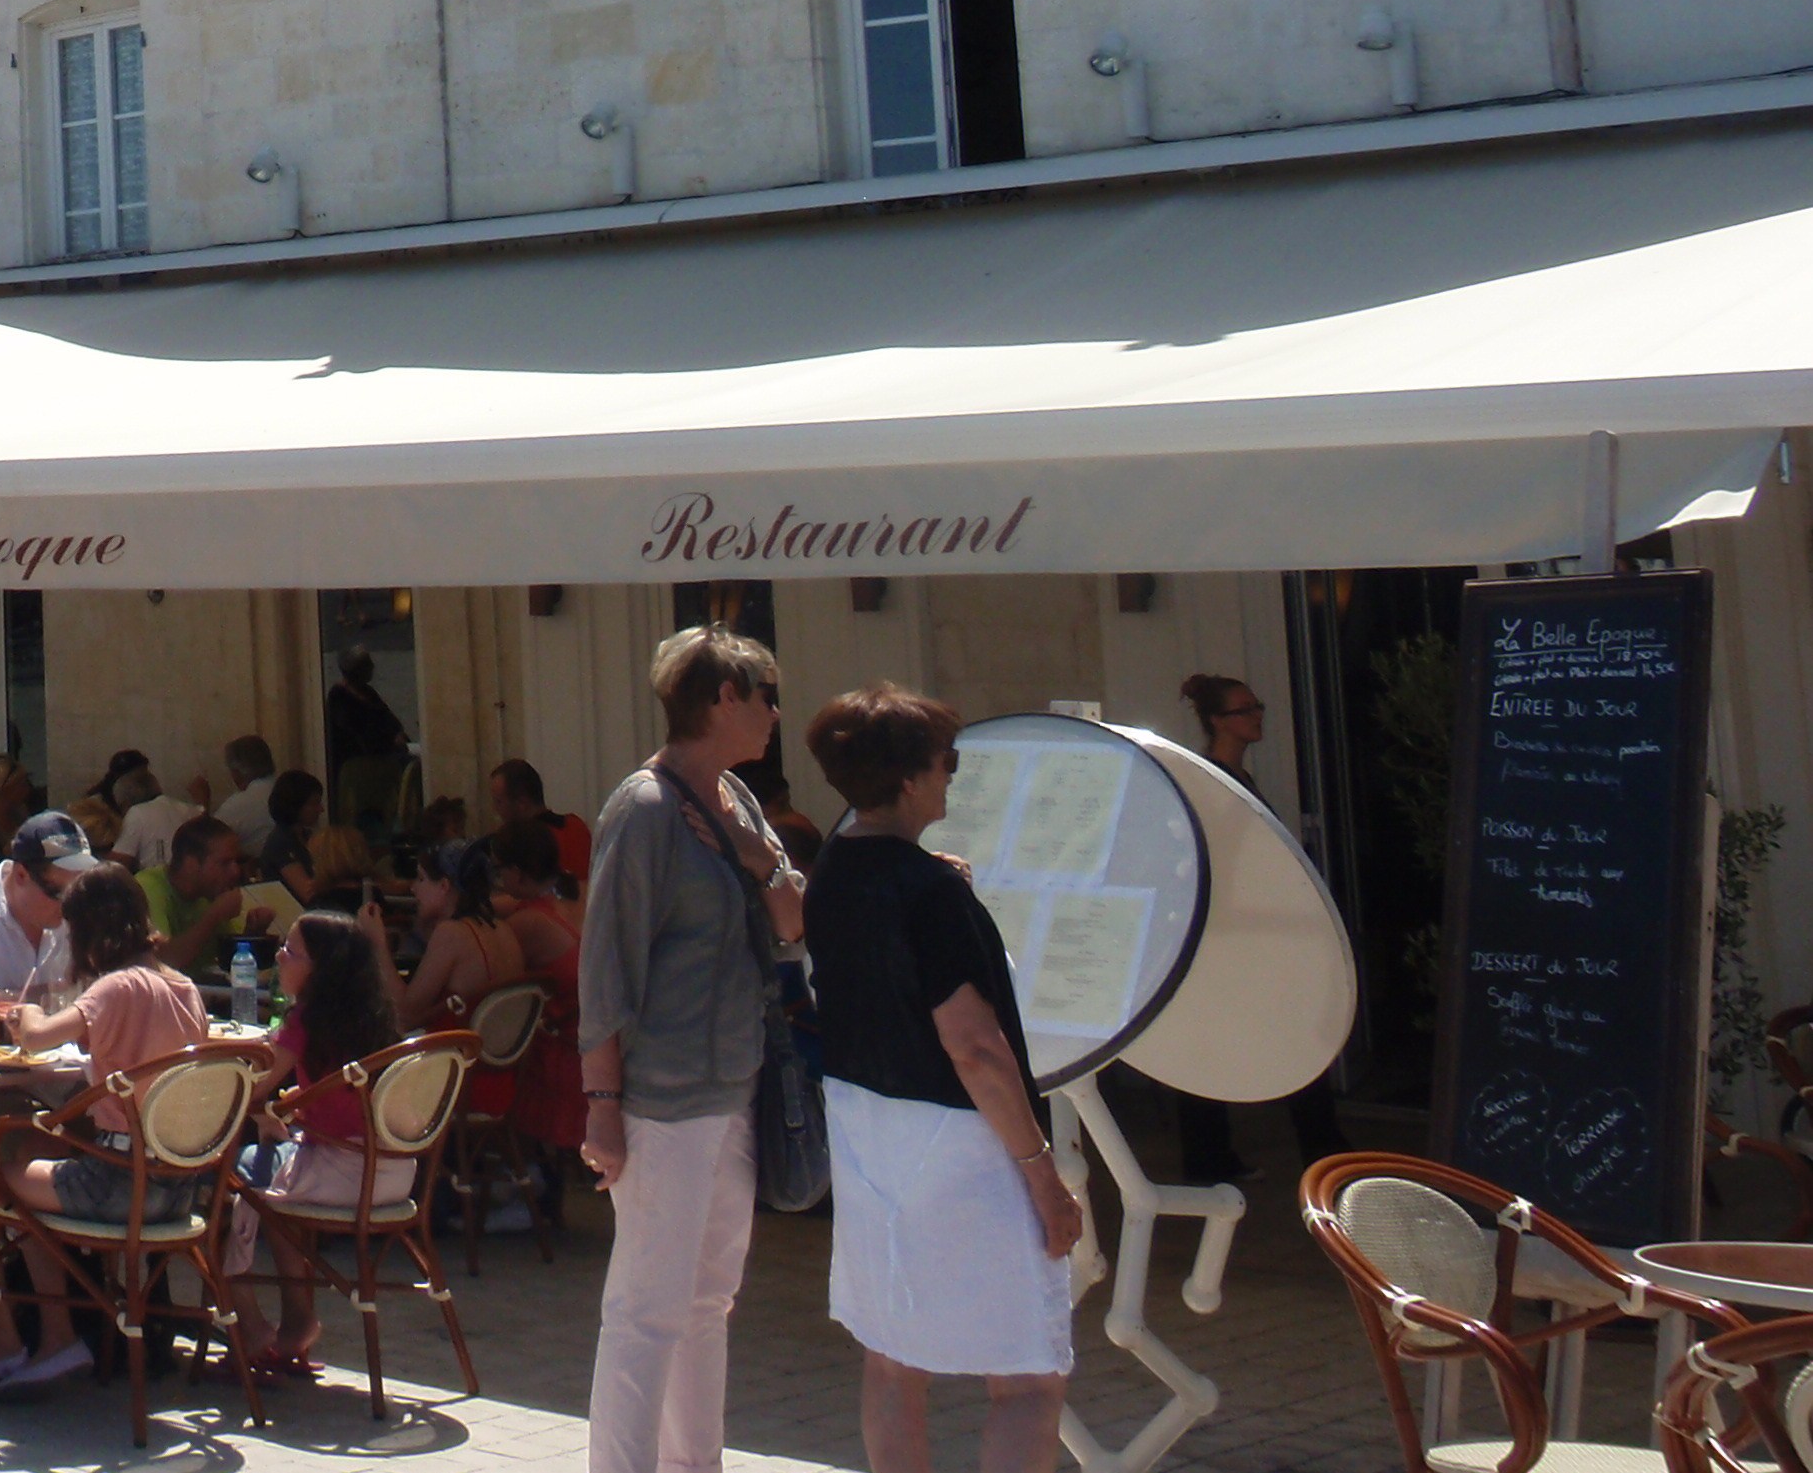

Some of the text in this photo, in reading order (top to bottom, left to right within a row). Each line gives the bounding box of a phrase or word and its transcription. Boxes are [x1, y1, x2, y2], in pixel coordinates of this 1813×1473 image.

[641, 491, 1037, 564] Restaurant
[1532, 621, 1577, 648] Belle
[1563, 698, 1586, 718] DU
